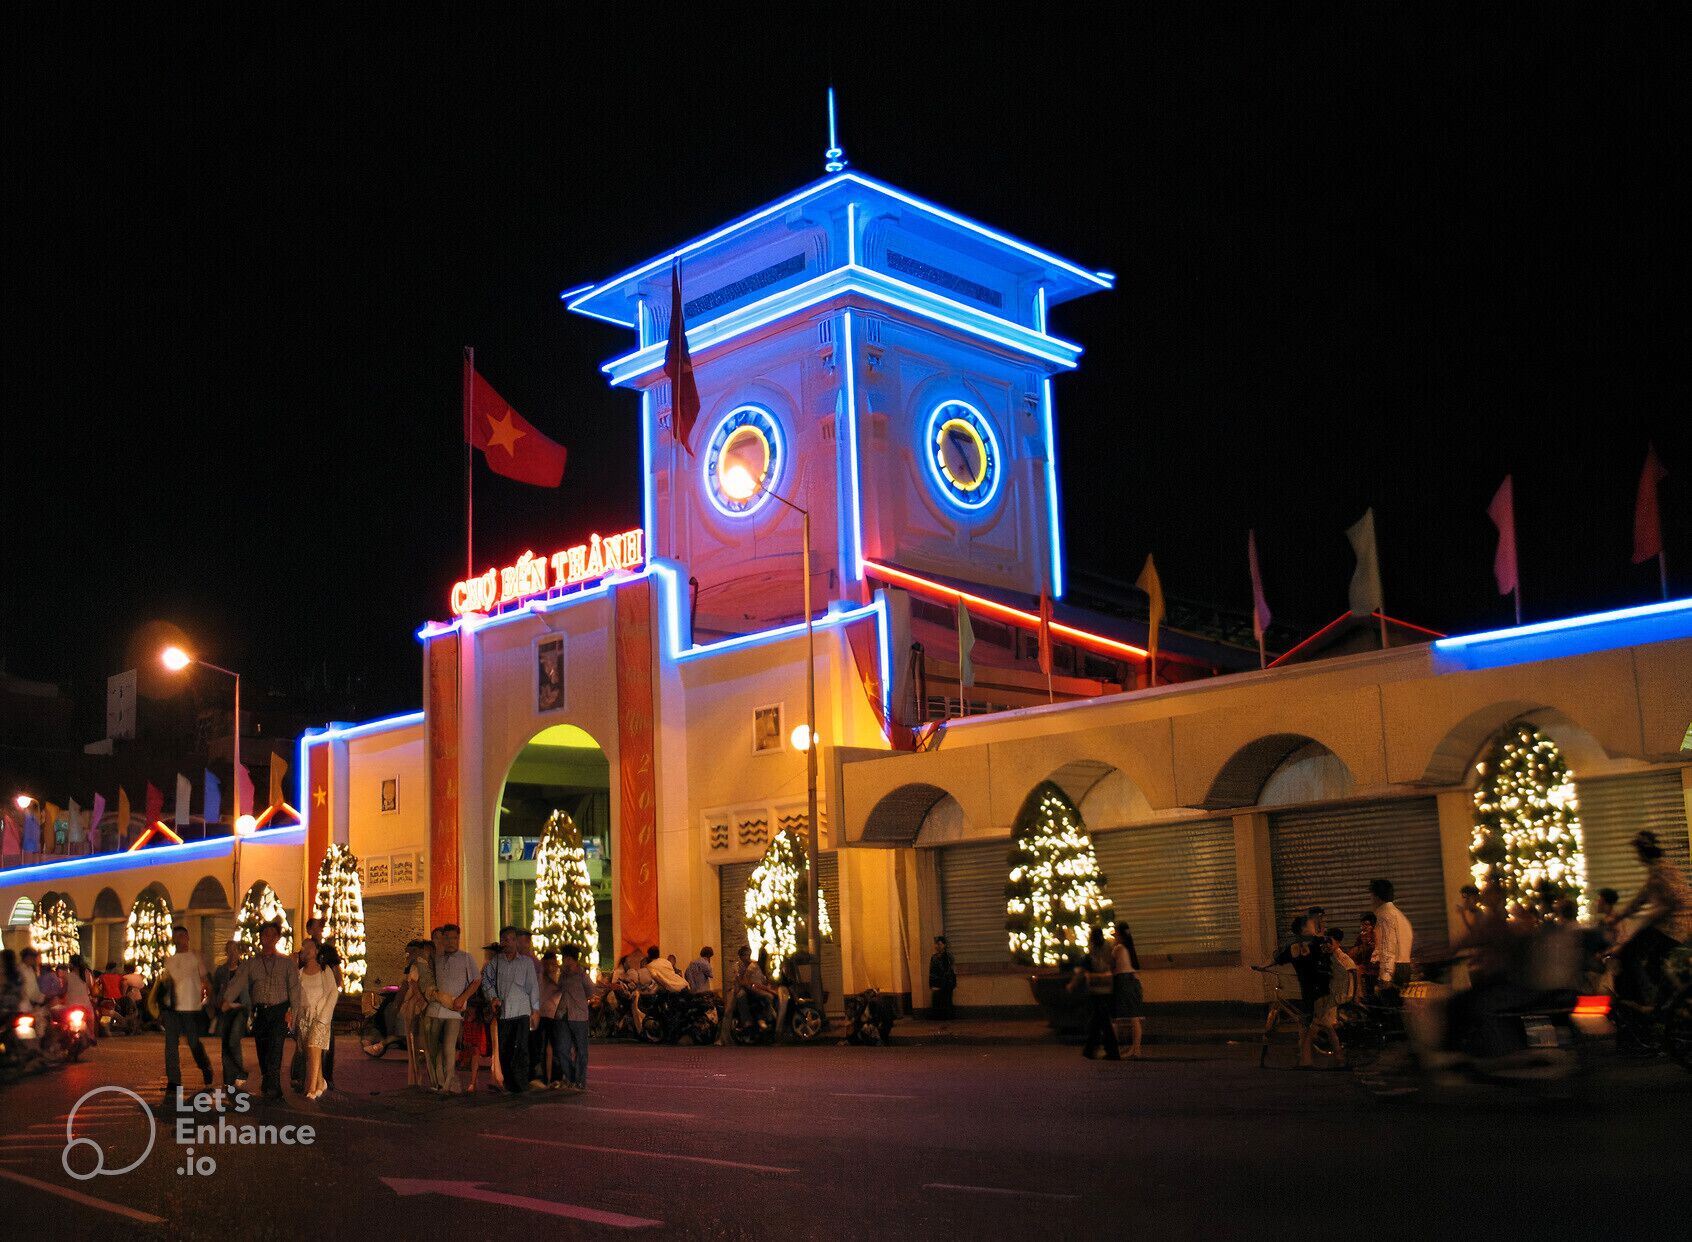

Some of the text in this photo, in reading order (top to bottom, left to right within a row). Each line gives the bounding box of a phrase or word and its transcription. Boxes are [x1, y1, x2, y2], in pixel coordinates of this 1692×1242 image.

[451, 528, 644, 615] CHỢ BẾN THÀNH
